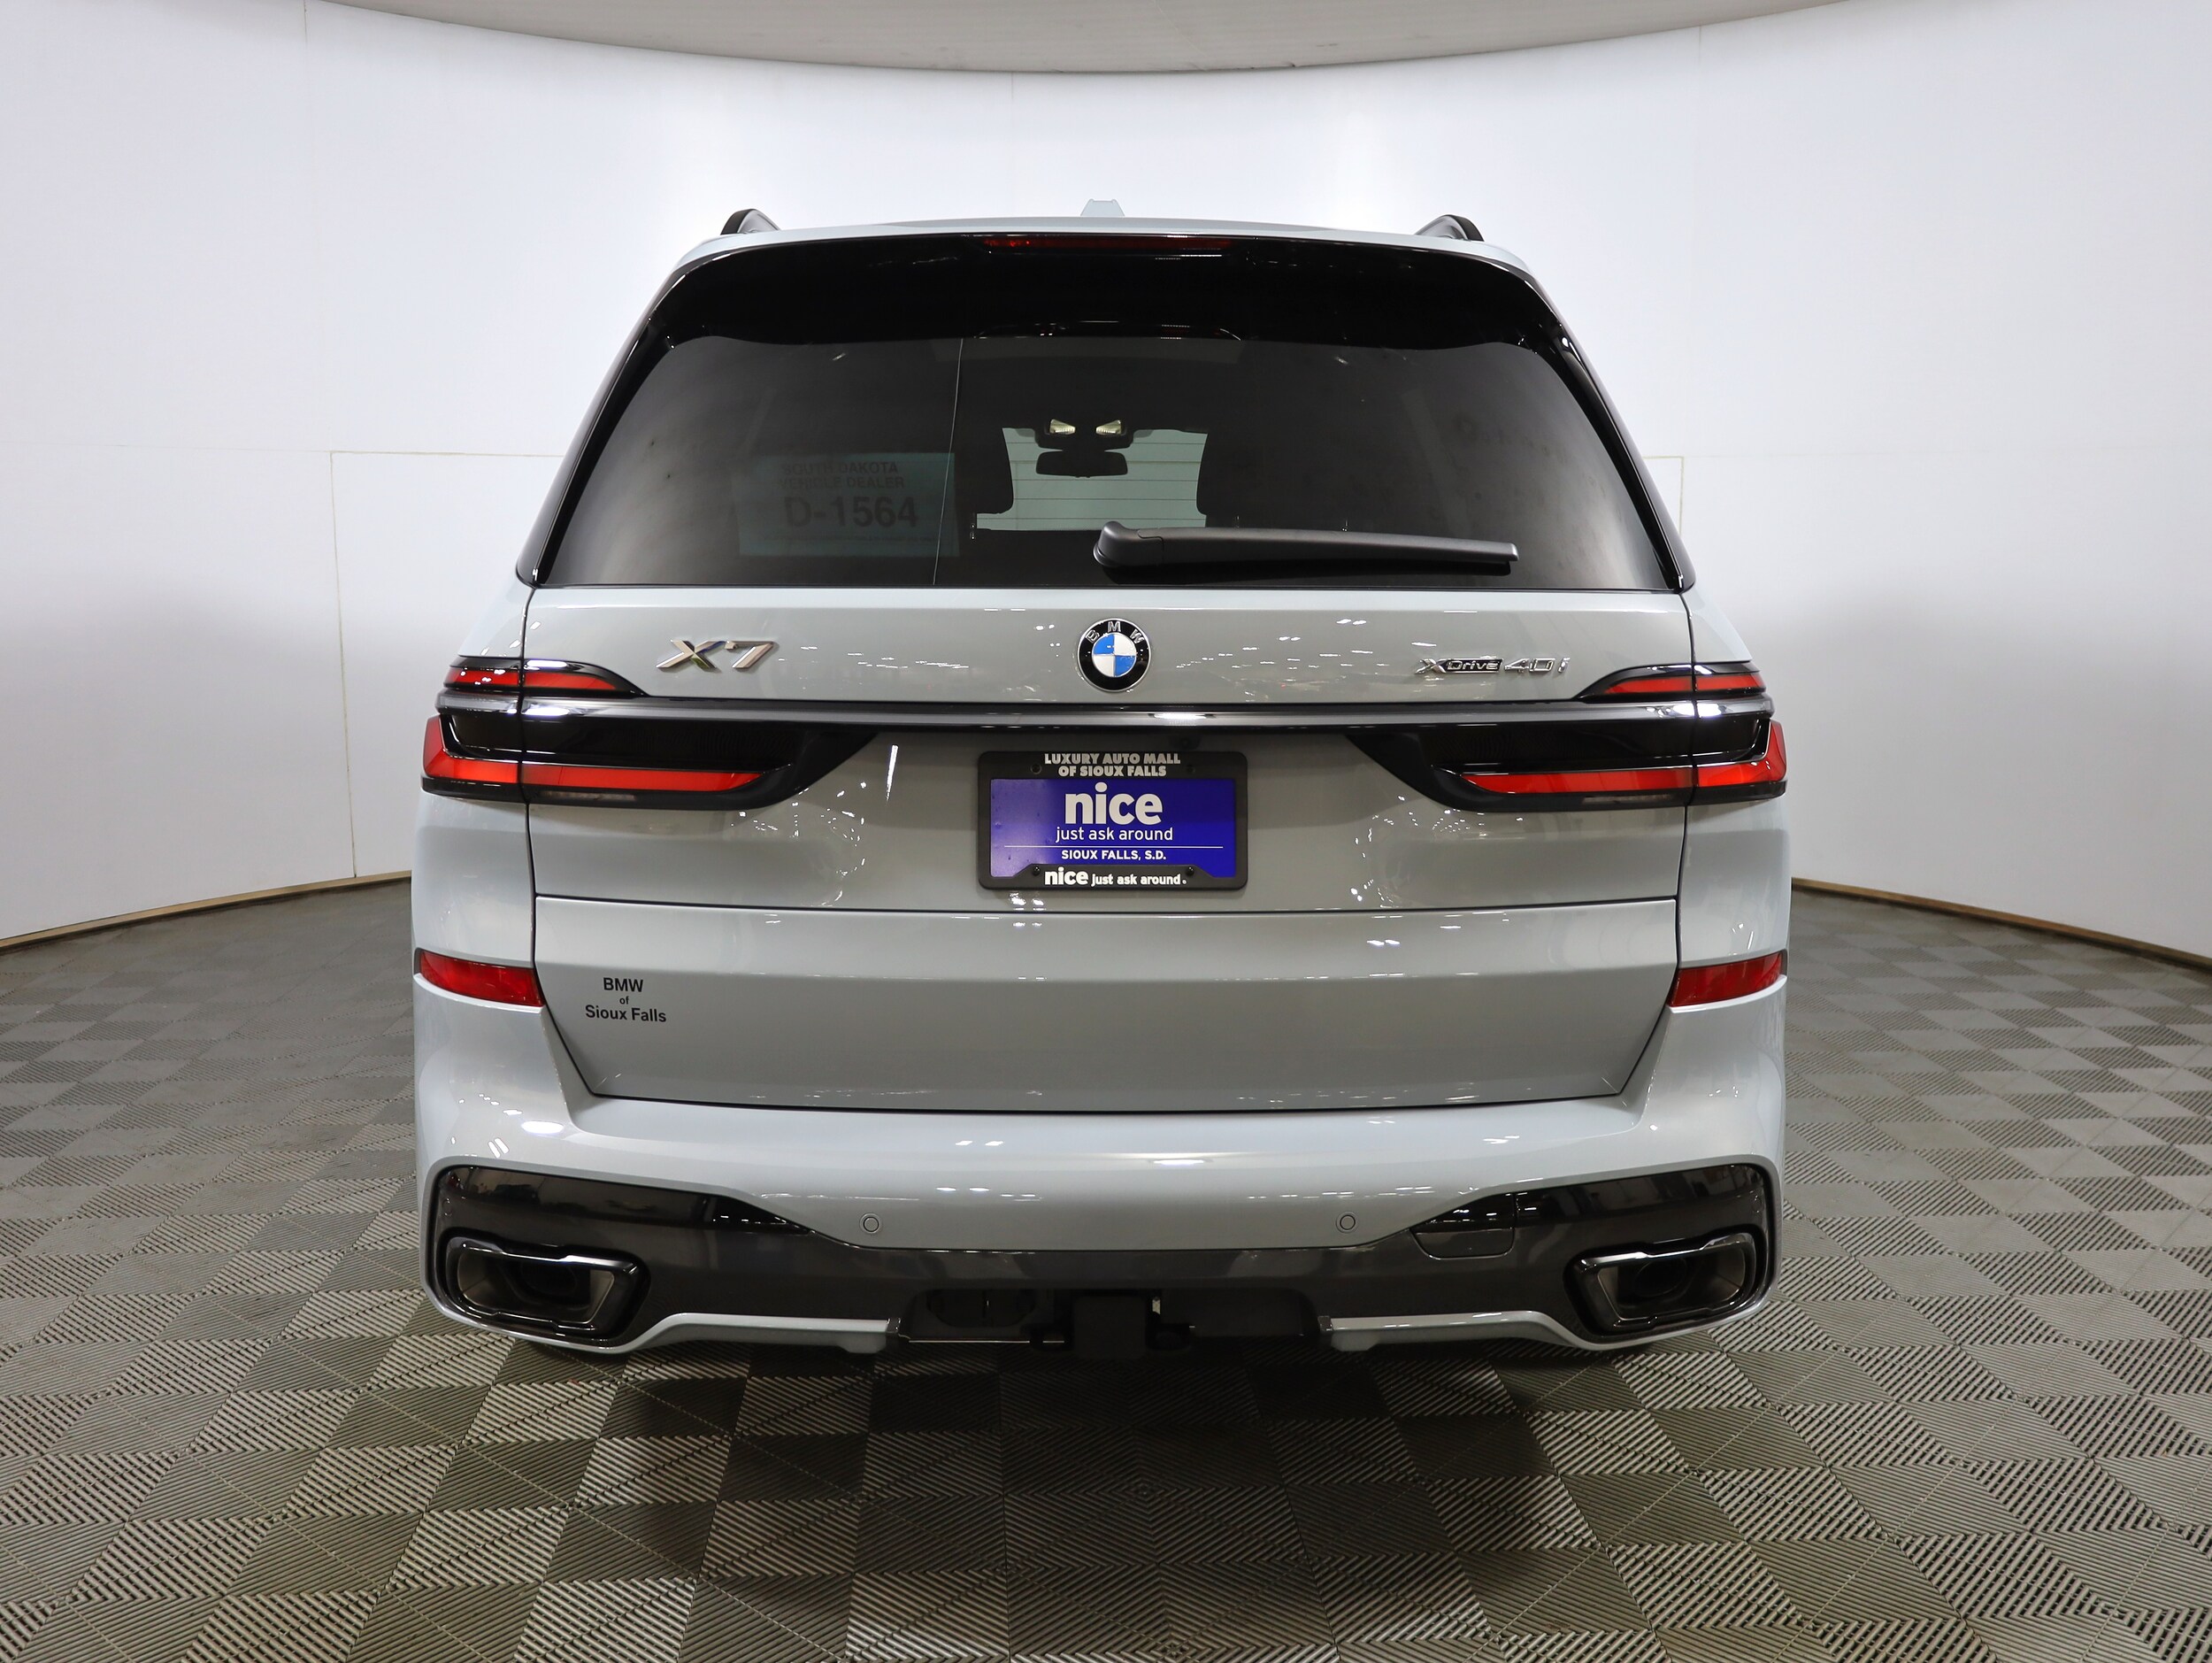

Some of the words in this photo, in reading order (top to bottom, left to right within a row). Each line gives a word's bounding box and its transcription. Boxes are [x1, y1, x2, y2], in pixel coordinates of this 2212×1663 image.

[838, 461, 899, 474] DAKOTA
[846, 476, 905, 489] DEALER
[784, 496, 919, 528] D-1564
[1085, 620, 1145, 644] BMW
[656, 639, 774, 670] X7
[1044, 753, 1100, 765] LUXURY
[1102, 753, 1141, 765] AUTO
[1143, 753, 1181, 765] MALL
[1057, 766, 1077, 777] OF
[1079, 766, 1125, 777] SIOUX
[1126, 766, 1167, 777] FALLS
[1064, 781, 1164, 826] nice
[1056, 826, 1085, 843] just
[1088, 827, 1115, 840] ask
[1118, 827, 1173, 841] around
[1061, 850, 1098, 860] SIOUX
[1101, 850, 1141, 861] FALLS,
[1144, 850, 1167, 860] S.D.
[1044, 866, 1089, 885] nice
[1091, 873, 1114, 887] just
[1117, 874, 1138, 885] ask
[603, 977, 644, 993] BMW
[618, 996, 630, 1005] of
[585, 1005, 627, 1020] Sioux
[631, 1007, 666, 1023] Falls
